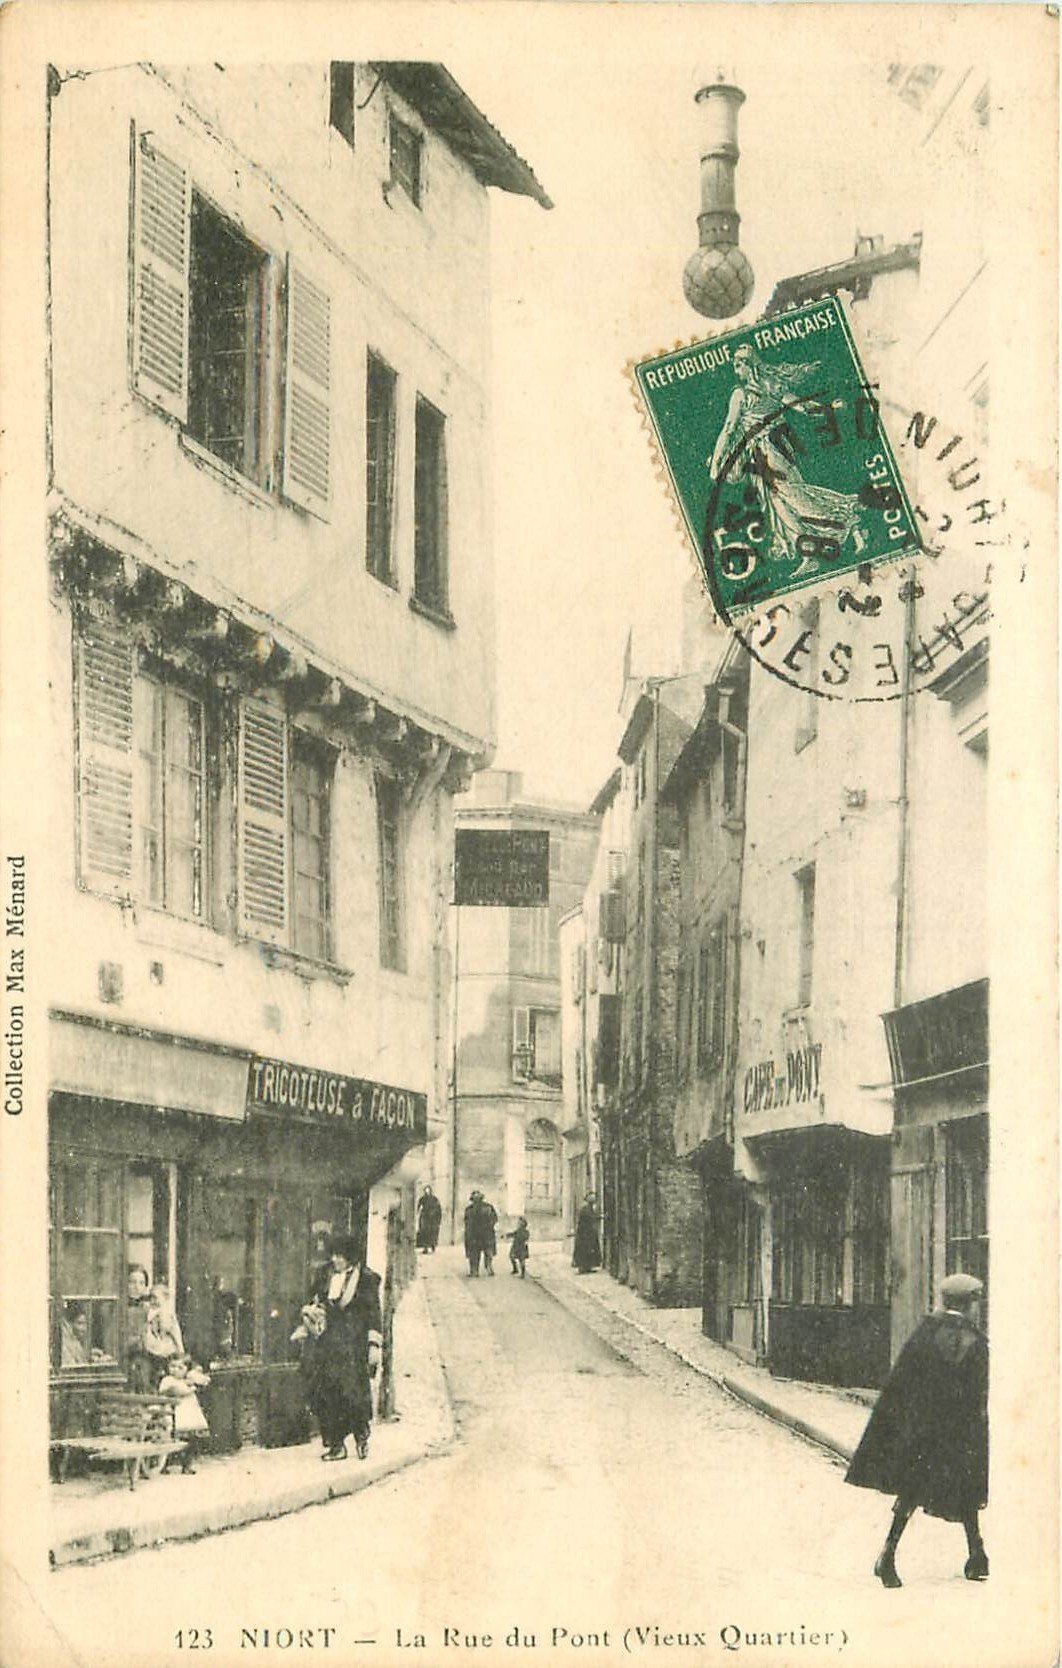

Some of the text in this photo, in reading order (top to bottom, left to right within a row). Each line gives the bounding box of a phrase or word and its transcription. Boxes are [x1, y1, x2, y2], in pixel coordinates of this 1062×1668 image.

[754, 308, 836, 350] FRANÇAISE
[253, 1062, 347, 1116] TRICOTEUSE
[370, 1087, 415, 1130] FAÇON
